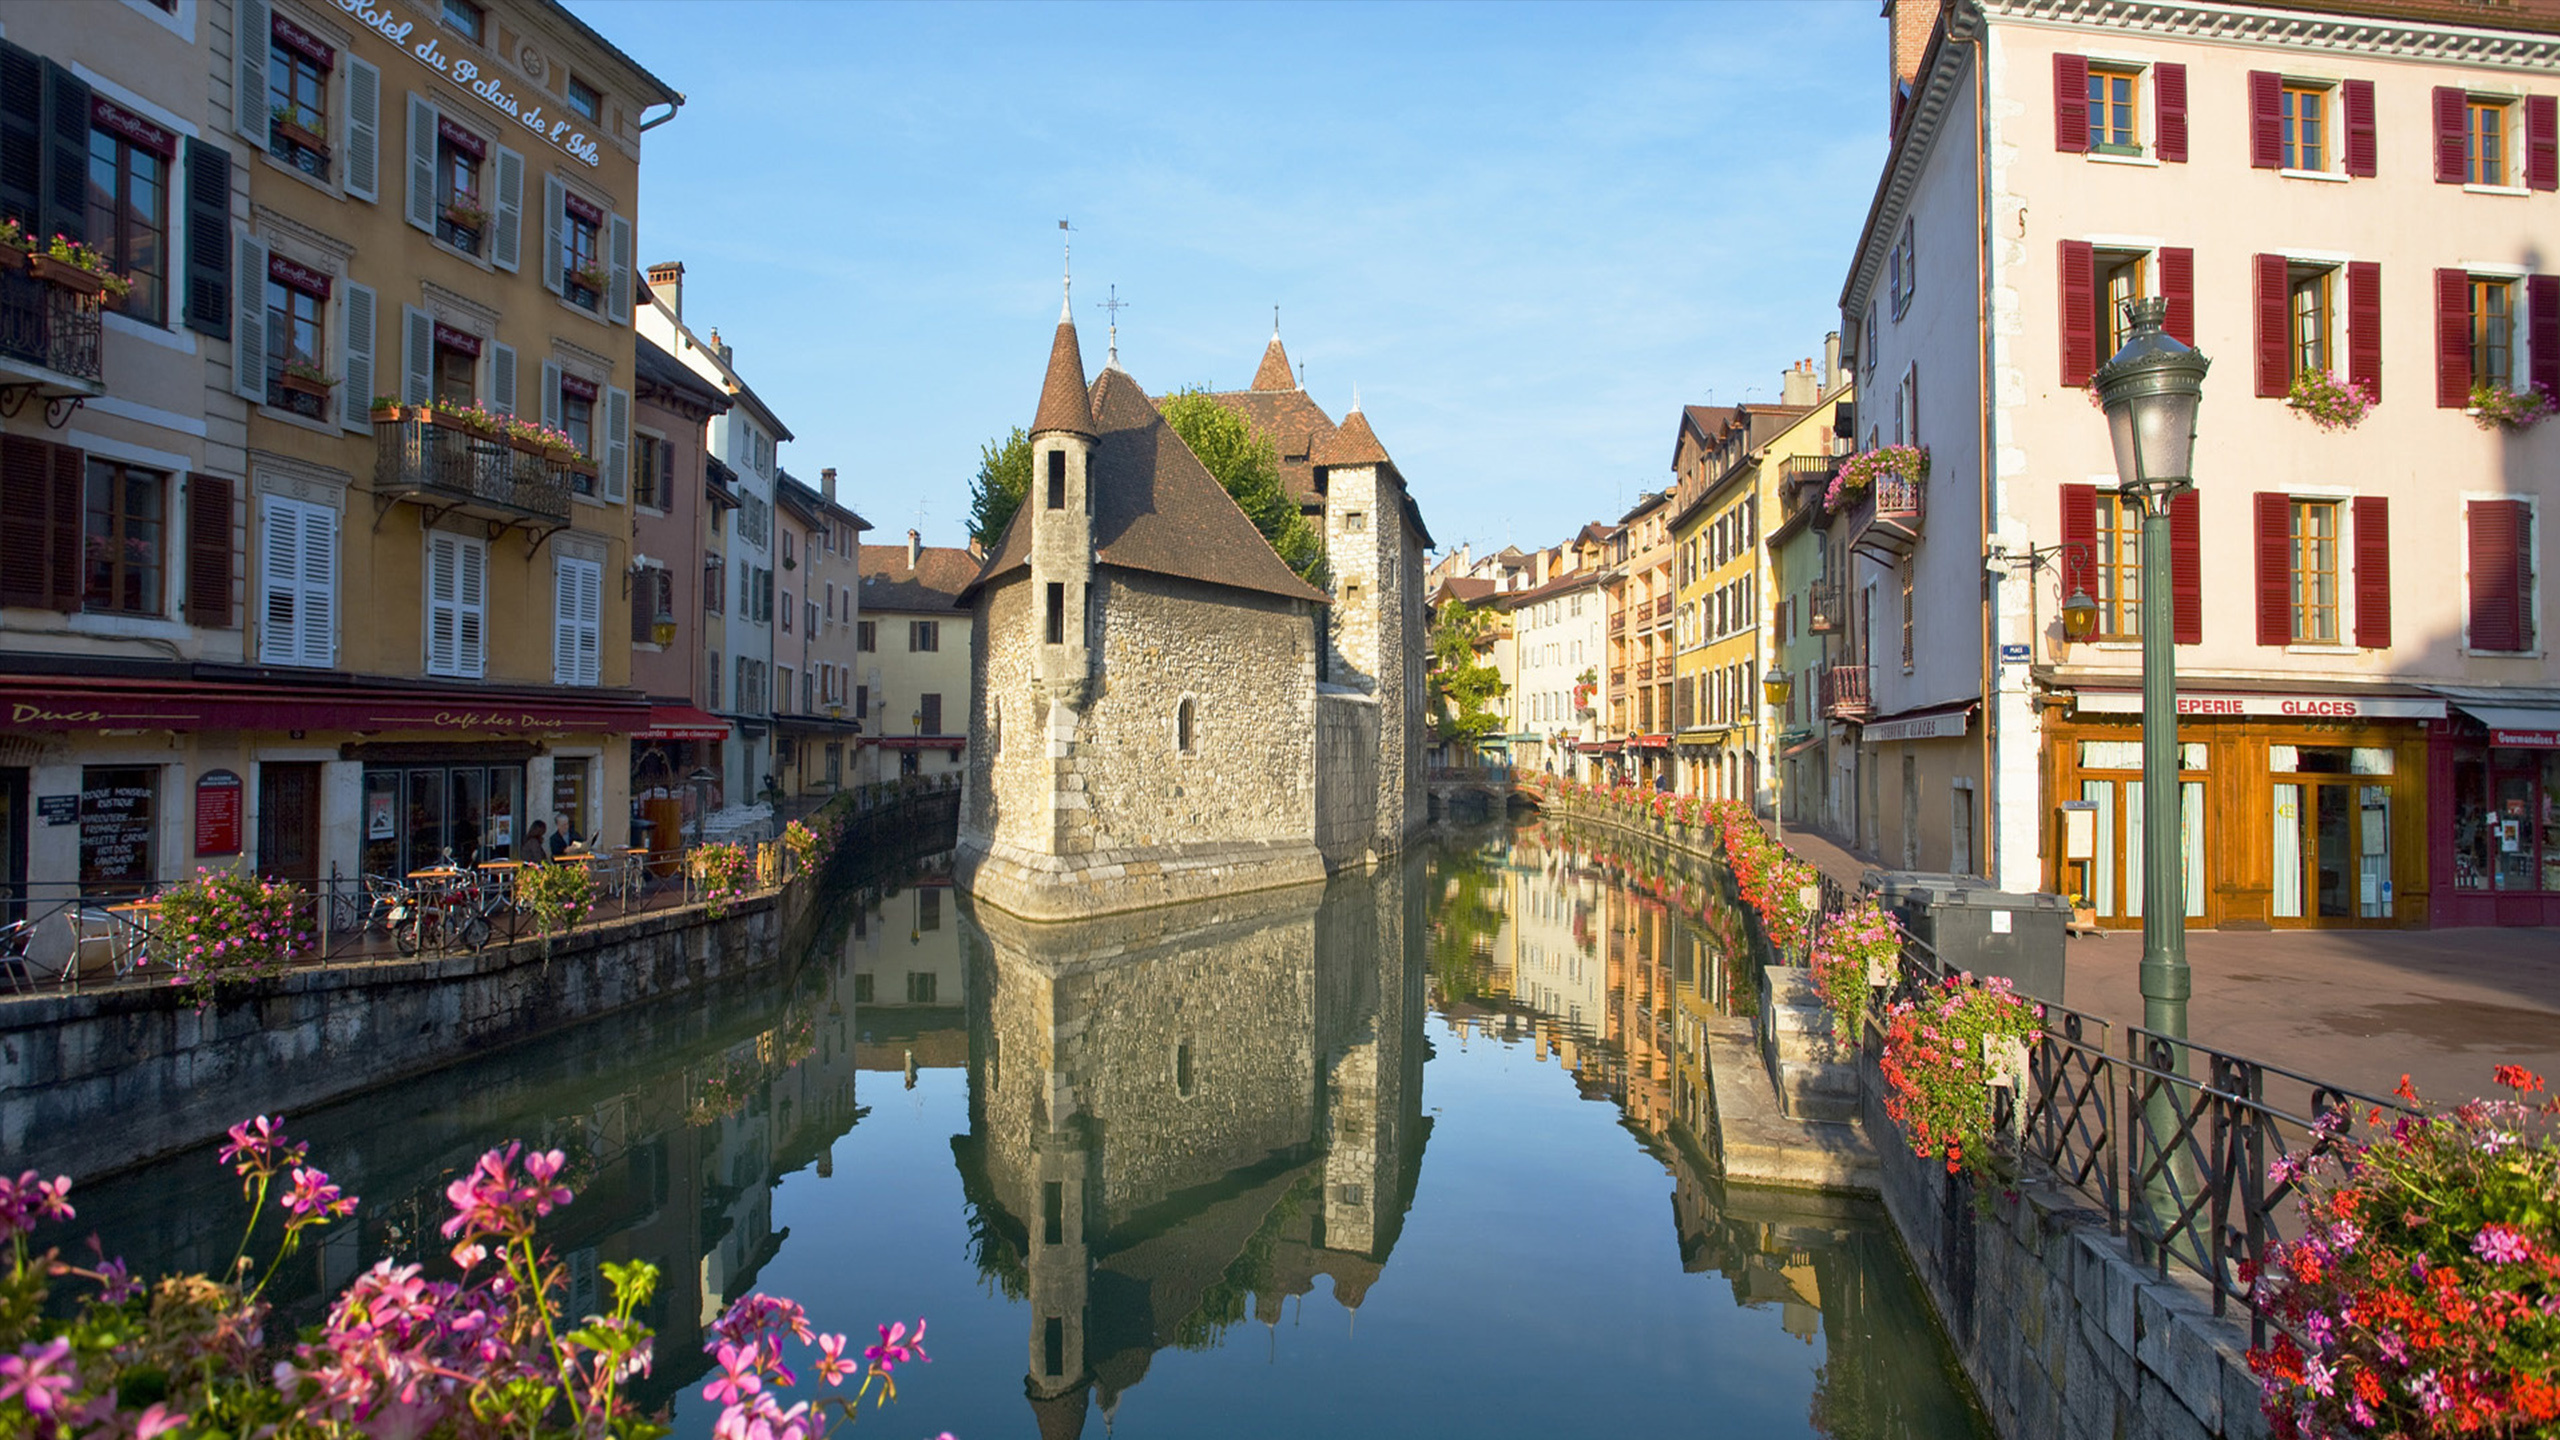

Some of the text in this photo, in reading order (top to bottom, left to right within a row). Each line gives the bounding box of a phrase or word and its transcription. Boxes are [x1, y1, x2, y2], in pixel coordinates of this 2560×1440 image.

[415, 39, 447, 72] du
[452, 59, 518, 117] Palais
[522, 107, 545, 133] de
[12, 703, 106, 723] Ducs
[2177, 699, 2357, 716] EPERIE GLACES
[434, 712, 562, 730] Café des Ducs
[1910, 721, 1936, 737] GLACES
[102, 865, 127, 876] SOUPE
